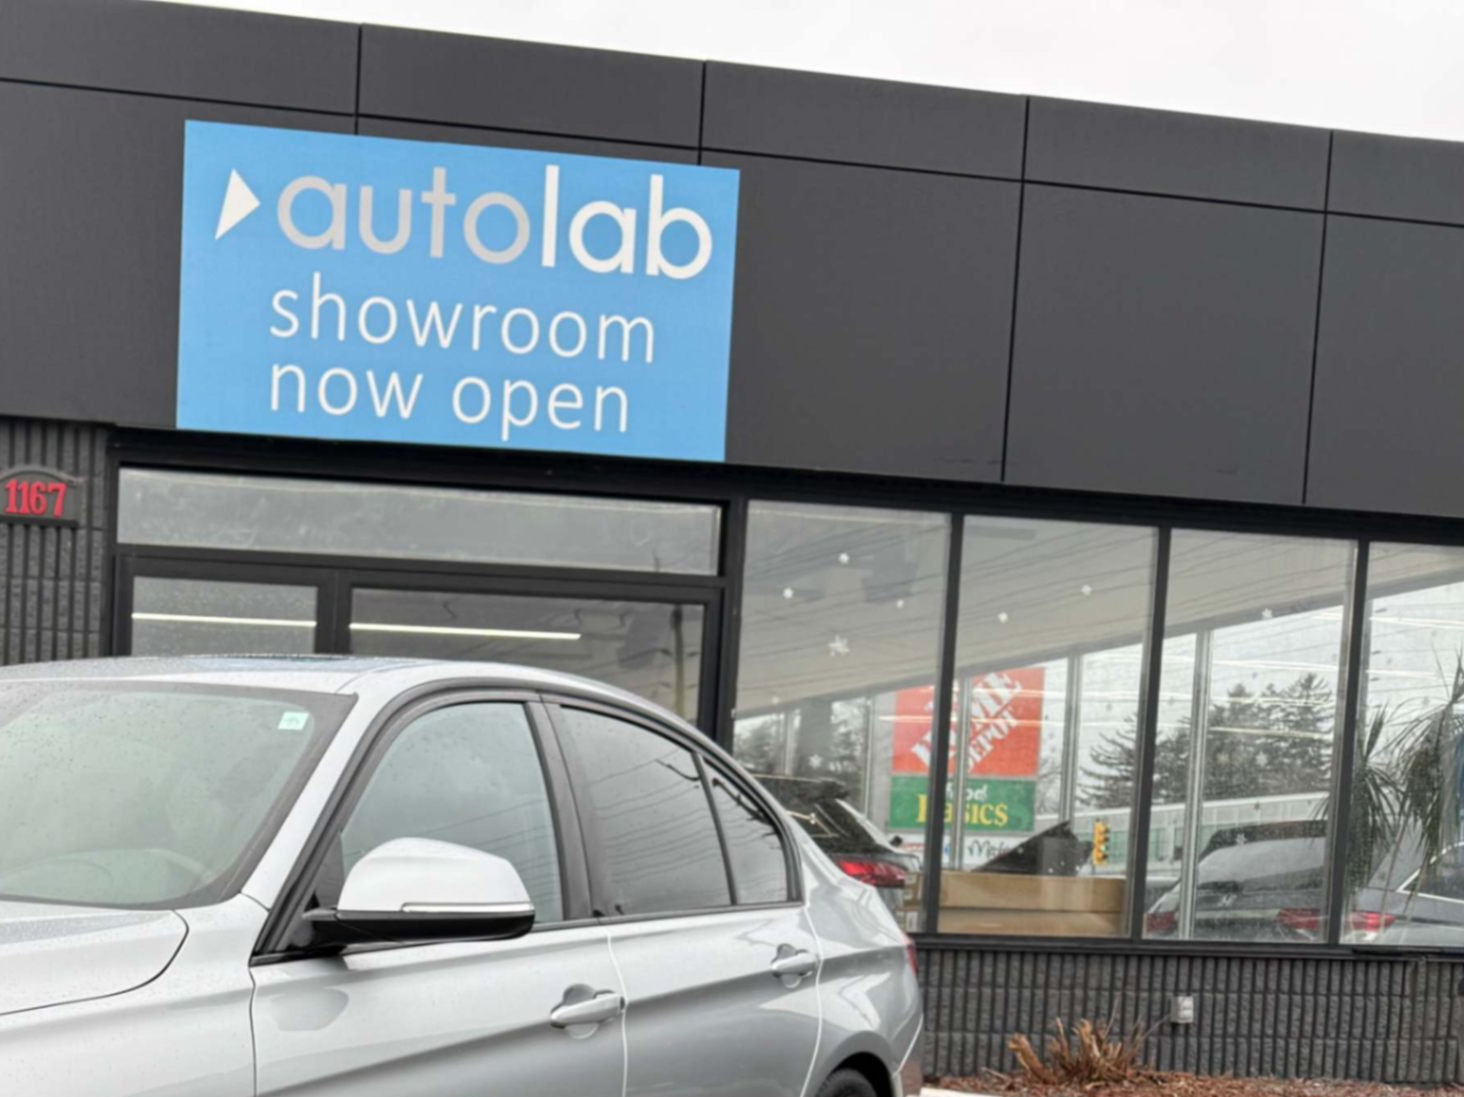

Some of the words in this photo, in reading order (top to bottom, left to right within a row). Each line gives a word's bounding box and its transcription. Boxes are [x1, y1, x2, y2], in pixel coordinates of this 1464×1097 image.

[276, 164, 713, 280] autolab
[269, 271, 654, 364] showroom
[270, 364, 423, 420] now
[452, 376, 628, 442] open
[4, 479, 68, 519] 1167
[911, 672, 1022, 770] HME
[963, 704, 1018, 775] EPOT
